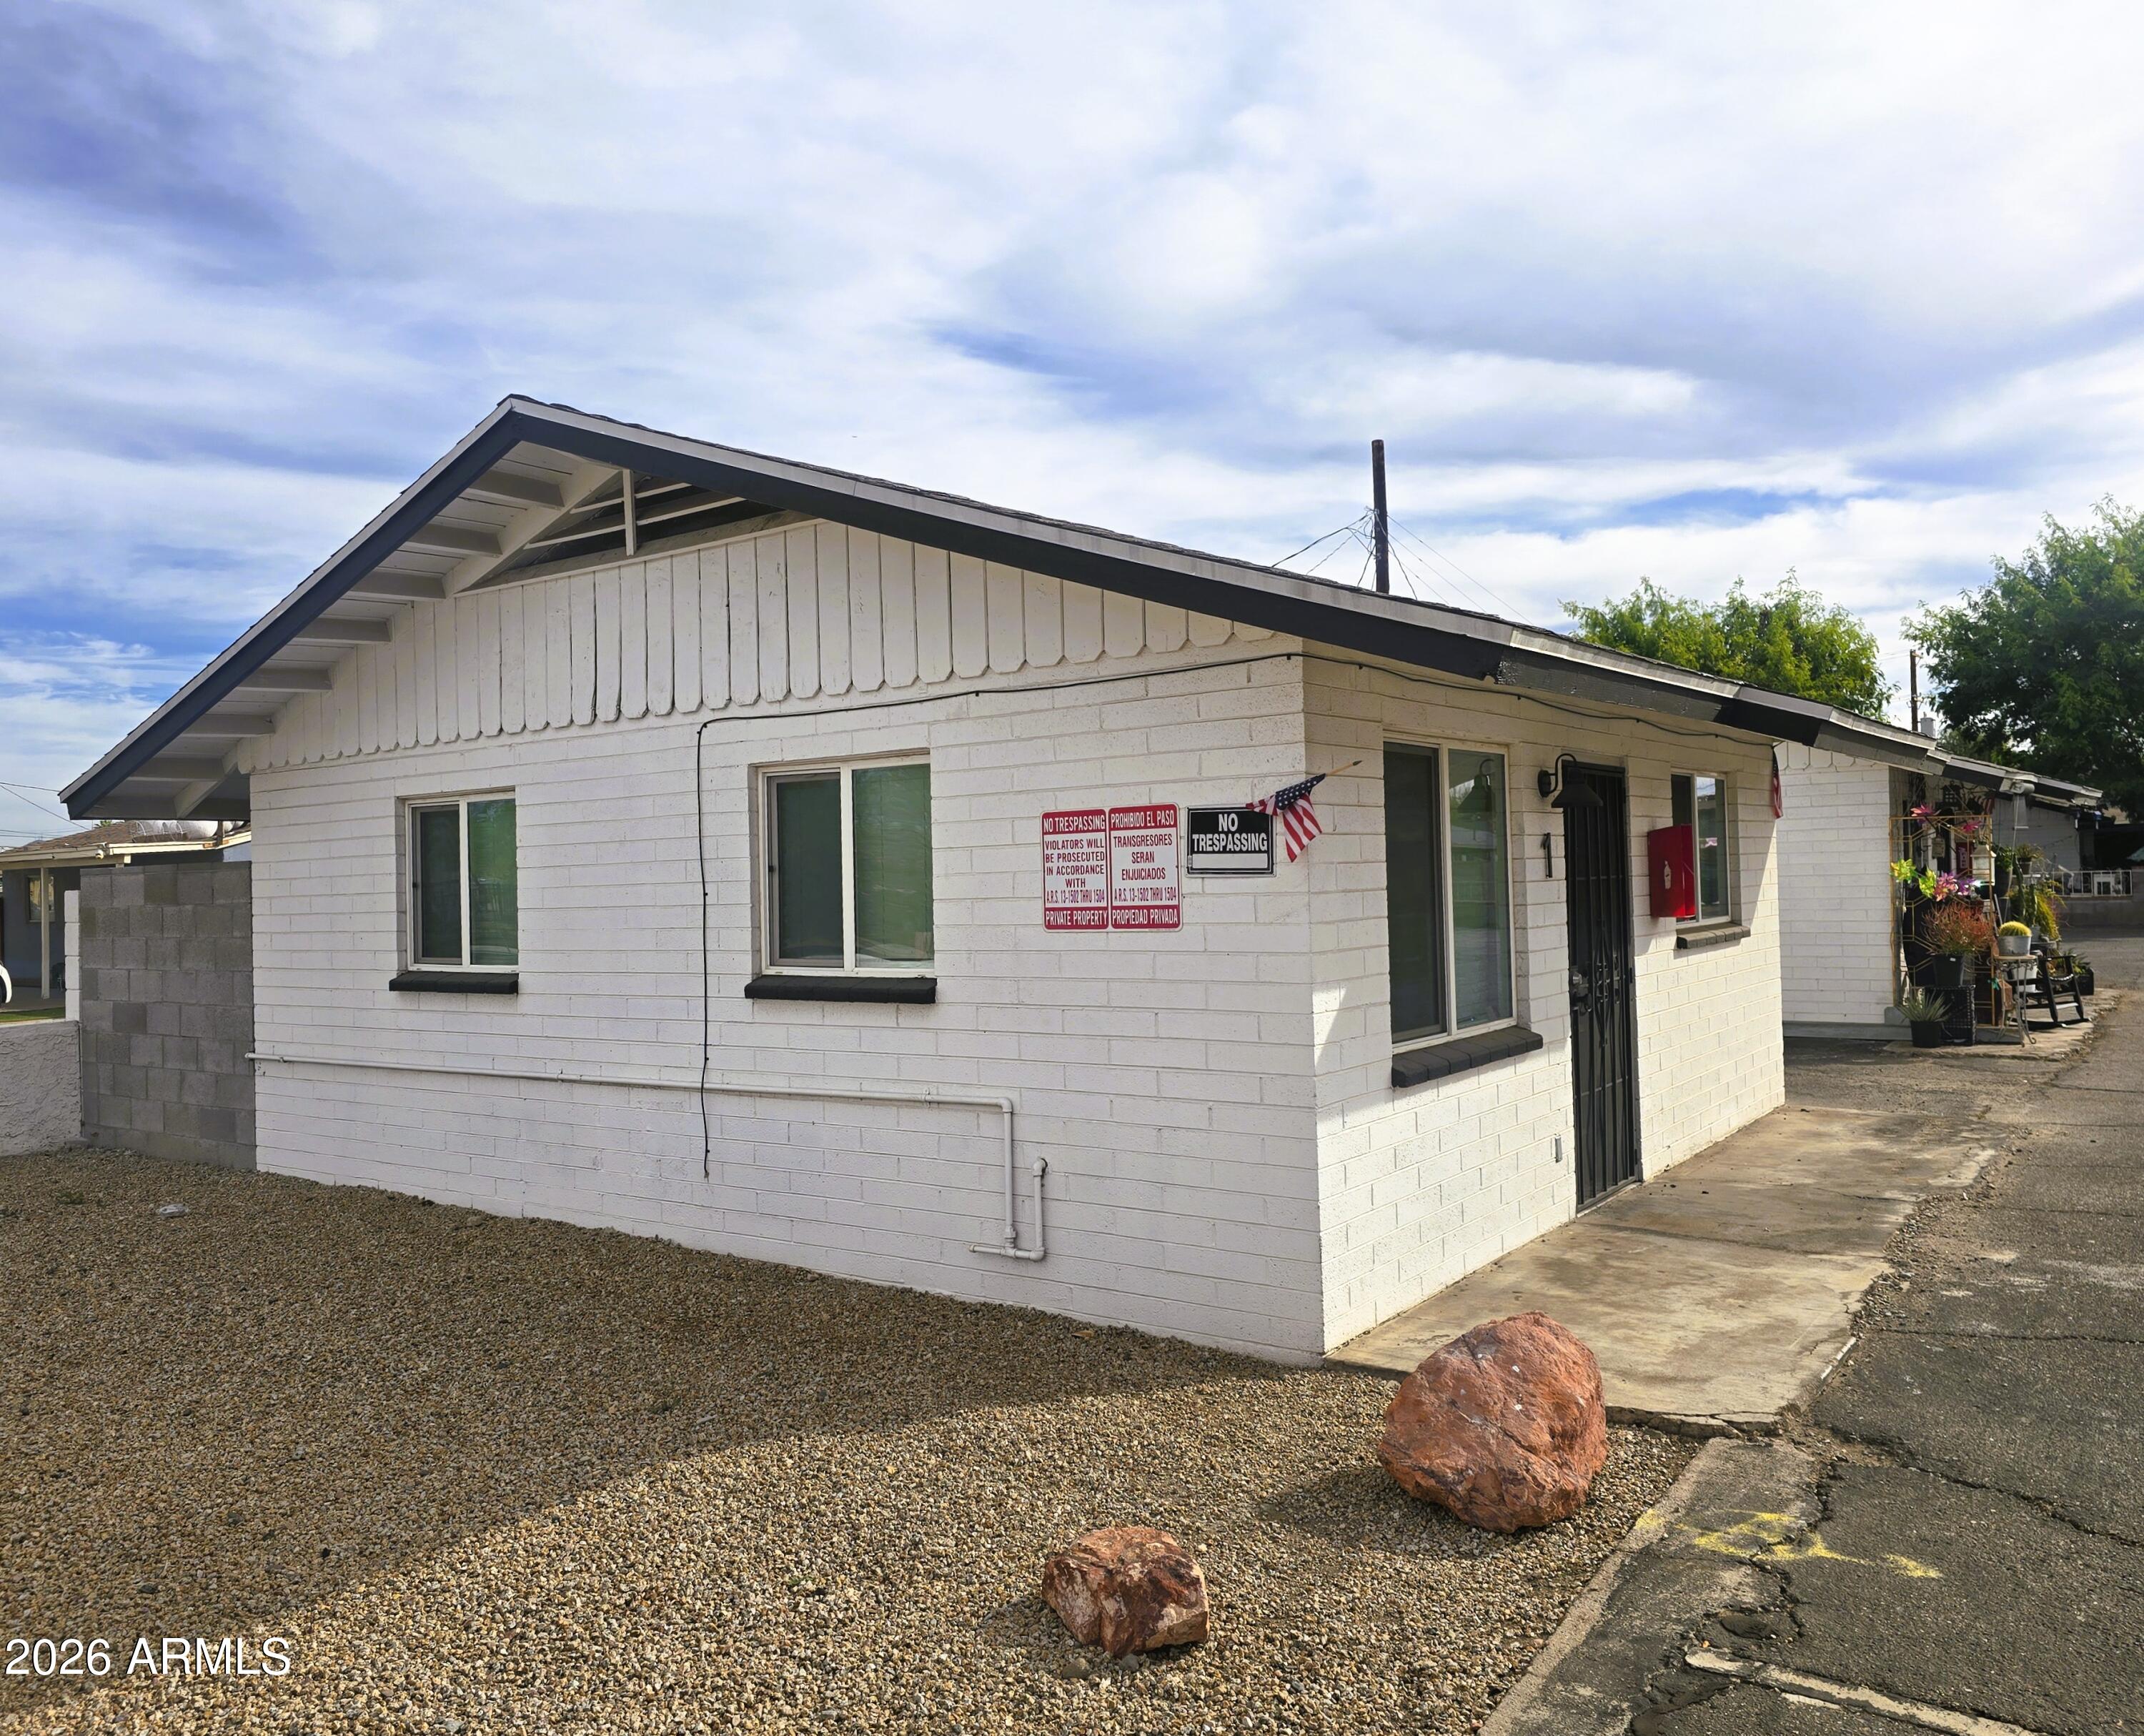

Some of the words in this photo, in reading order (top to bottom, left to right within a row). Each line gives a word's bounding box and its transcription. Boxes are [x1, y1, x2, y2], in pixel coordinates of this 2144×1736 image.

[1043, 818, 1053, 833] NO
[1055, 815, 1106, 831] TRESPASSING
[1111, 812, 1144, 828] PROHIBIDO
[1146, 811, 1155, 826] EL
[1157, 810, 1174, 825] PASO
[1219, 813, 1239, 832] NO
[1045, 839, 1084, 850] VIOLATORS
[1086, 838, 1104, 849] WILL
[1113, 833, 1173, 848] TRANSGRESORES
[1192, 833, 1268, 851] TRESPASSING
[1046, 853, 1054, 863] BE
[1057, 851, 1105, 863] PROSECUTED
[1131, 851, 1155, 864] SERAN
[1540, 832, 1552, 878] 1
[1046, 866, 1053, 876] IN
[1056, 865, 1105, 876] ACCORDANCE
[1121, 868, 1166, 881] ENJUICIADOS
[1065, 878, 1086, 888] WITH
[1080, 889, 1093, 903] THRU
[1129, 887, 1149, 902] 13-1502
[1150, 887, 1163, 902] THRU
[1164, 886, 1177, 901] 1504
[1046, 911, 1071, 926] PRIVATE
[1073, 910, 1108, 925] PROPERTY
[1112, 909, 1148, 925] PROPIEDAD
[1150, 908, 1178, 924] PRIVADA
